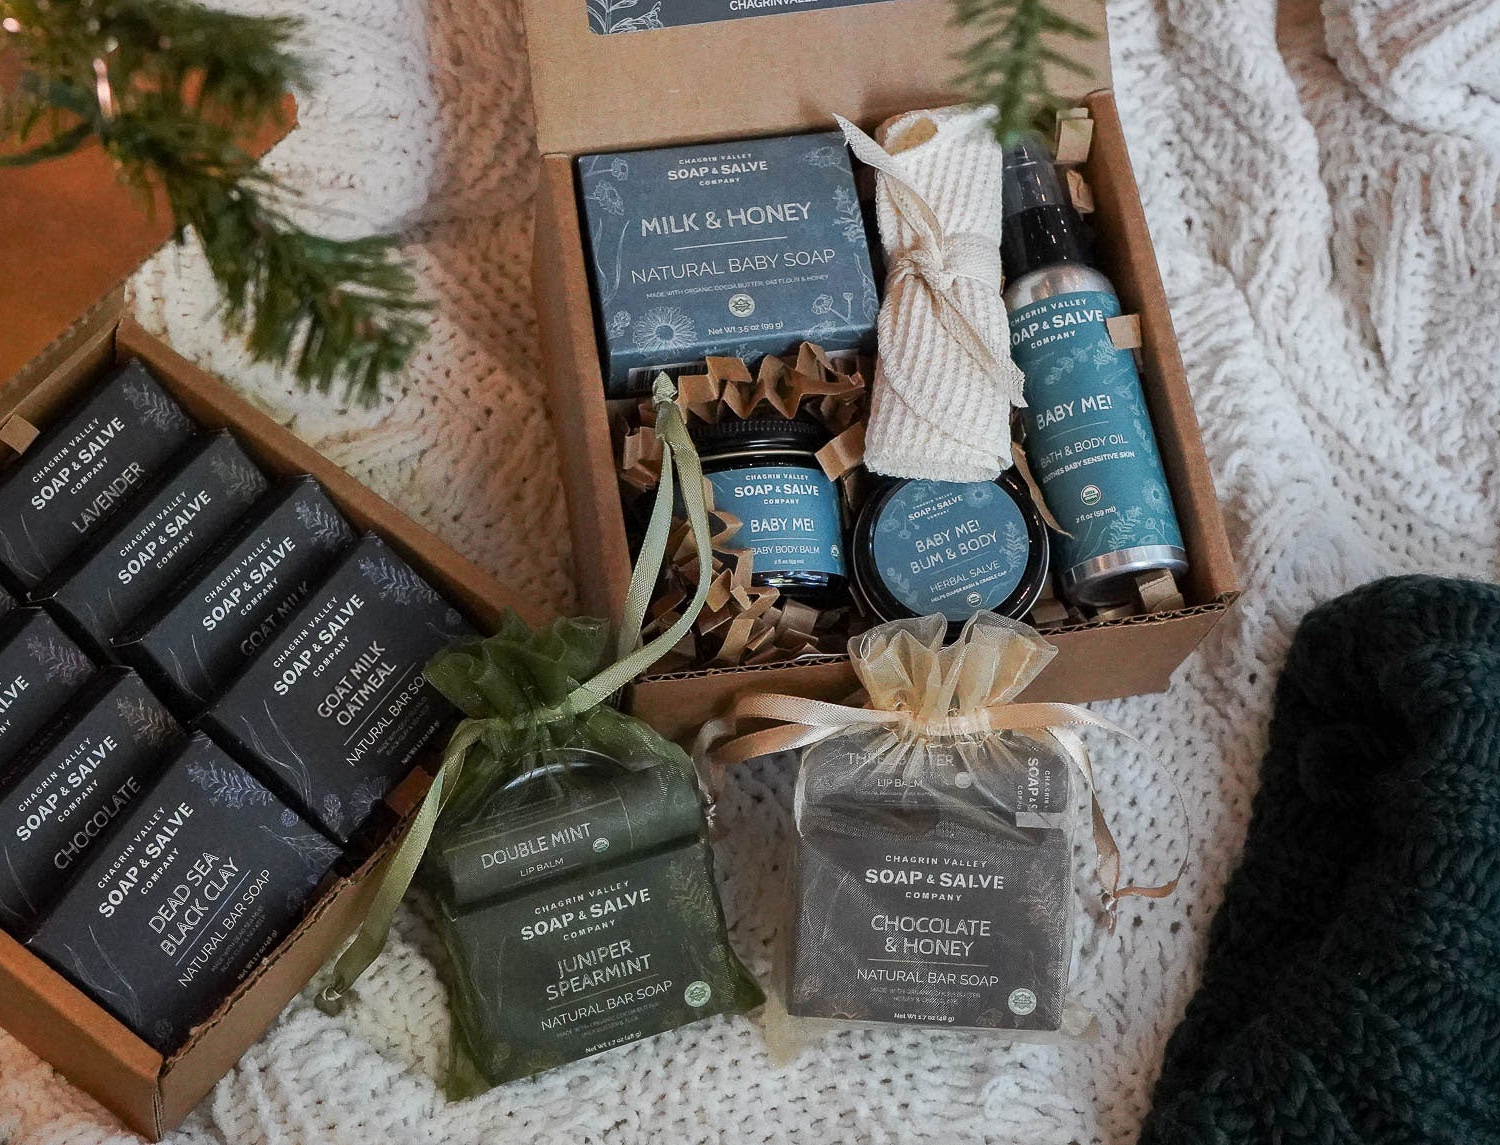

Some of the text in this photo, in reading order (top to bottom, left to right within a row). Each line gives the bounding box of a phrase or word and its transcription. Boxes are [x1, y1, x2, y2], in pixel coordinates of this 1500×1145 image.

[667, 169, 709, 181] SOAP
[721, 160, 768, 175] SALVE
[678, 156, 717, 165] CHAGRIN
[699, 178, 740, 186] COMPANY
[641, 201, 811, 236] MILK & HONEY
[631, 249, 836, 284] NATURAL BABY SOAP
[708, 327, 722, 335] Net
[761, 322, 774, 331] (99
[775, 321, 783, 330] g)
[1010, 298, 1087, 326] CHAGRIN VALLEY
[1042, 321, 1050, 330] &
[1052, 310, 1104, 328] SALVE
[1031, 330, 1076, 349] COMPANY
[1036, 394, 1113, 431] BABY ME!
[31, 417, 125, 510] SOAP & SALVE
[32, 418, 100, 483] CHAGRIN VALLEY
[1040, 435, 1128, 468] BATH & BODY OIL
[1065, 461, 1082, 473] BABY
[1083, 453, 1119, 466] SENSITIVE
[70, 456, 109, 495] COMPANY
[734, 485, 773, 497] SOAP
[784, 484, 819, 496] SALVE
[71, 461, 146, 533] LAVENDER
[908, 495, 964, 521] SOAP SALVE
[118, 490, 212, 584] SOAP & SALVE
[119, 491, 187, 557] CHAGRIN VALLEY
[751, 518, 814, 532] BABY ME!
[915, 519, 980, 553] BABY ME!
[156, 530, 194, 569] COMPANY
[910, 531, 998, 574] BUM & BODY
[202, 536, 296, 631] SOAP & SALVE
[204, 538, 272, 603] CHAGRIN VALLEY
[930, 561, 1000, 592] HERBAL SALVE
[240, 578, 279, 616] COMPANY
[240, 614, 276, 656] GOAT
[273, 596, 338, 668] CHAGRIN VALLEY
[274, 594, 364, 696] SOAP & SALVE
[313, 636, 350, 678] COMPANY
[317, 640, 386, 718] GOAT MILK
[336, 662, 397, 726] OATMEAL
[345, 716, 393, 767] NATURAL
[388, 692, 412, 717] BAR
[16, 736, 118, 842] SOAP & SALVE
[18, 737, 92, 812] CHAGRIN VALLEY
[57, 780, 99, 823] COMPANY
[53, 776, 141, 870] CHOCOLATE
[97, 806, 165, 889] CHAGRIN VALLEY
[98, 802, 194, 918] SOAP & SALVE
[481, 823, 591, 869] DOUBLE MINT
[885, 855, 987, 868] CHAGRIN VALLEY
[140, 848, 179, 895] COMPANY
[520, 857, 564, 877] LIP BALM
[865, 869, 1004, 889] SOAP & SALVE
[148, 852, 220, 934] DEAD SEA
[160, 899, 209, 957] BLACK
[203, 857, 240, 900] CLAY
[534, 880, 630, 914] CHAGRIN VALLEY
[905, 891, 962, 901] COMPANY
[177, 932, 228, 987] NATURAL
[222, 903, 247, 929] BAR
[243, 869, 271, 904] SOAP
[521, 888, 651, 941] SOAP & SALVE
[563, 919, 615, 941] COMPANY
[870, 914, 992, 936] CHOCOLATE
[557, 939, 634, 979] JUNIPER
[884, 936, 975, 957] & HONEY
[546, 954, 652, 1001] SPEARMINT
[857, 968, 999, 987] NATURAL BAR SOAP
[541, 1003, 605, 1031] NATURAL
[606, 992, 634, 1010] BAR
[637, 980, 673, 1000] SOAP
